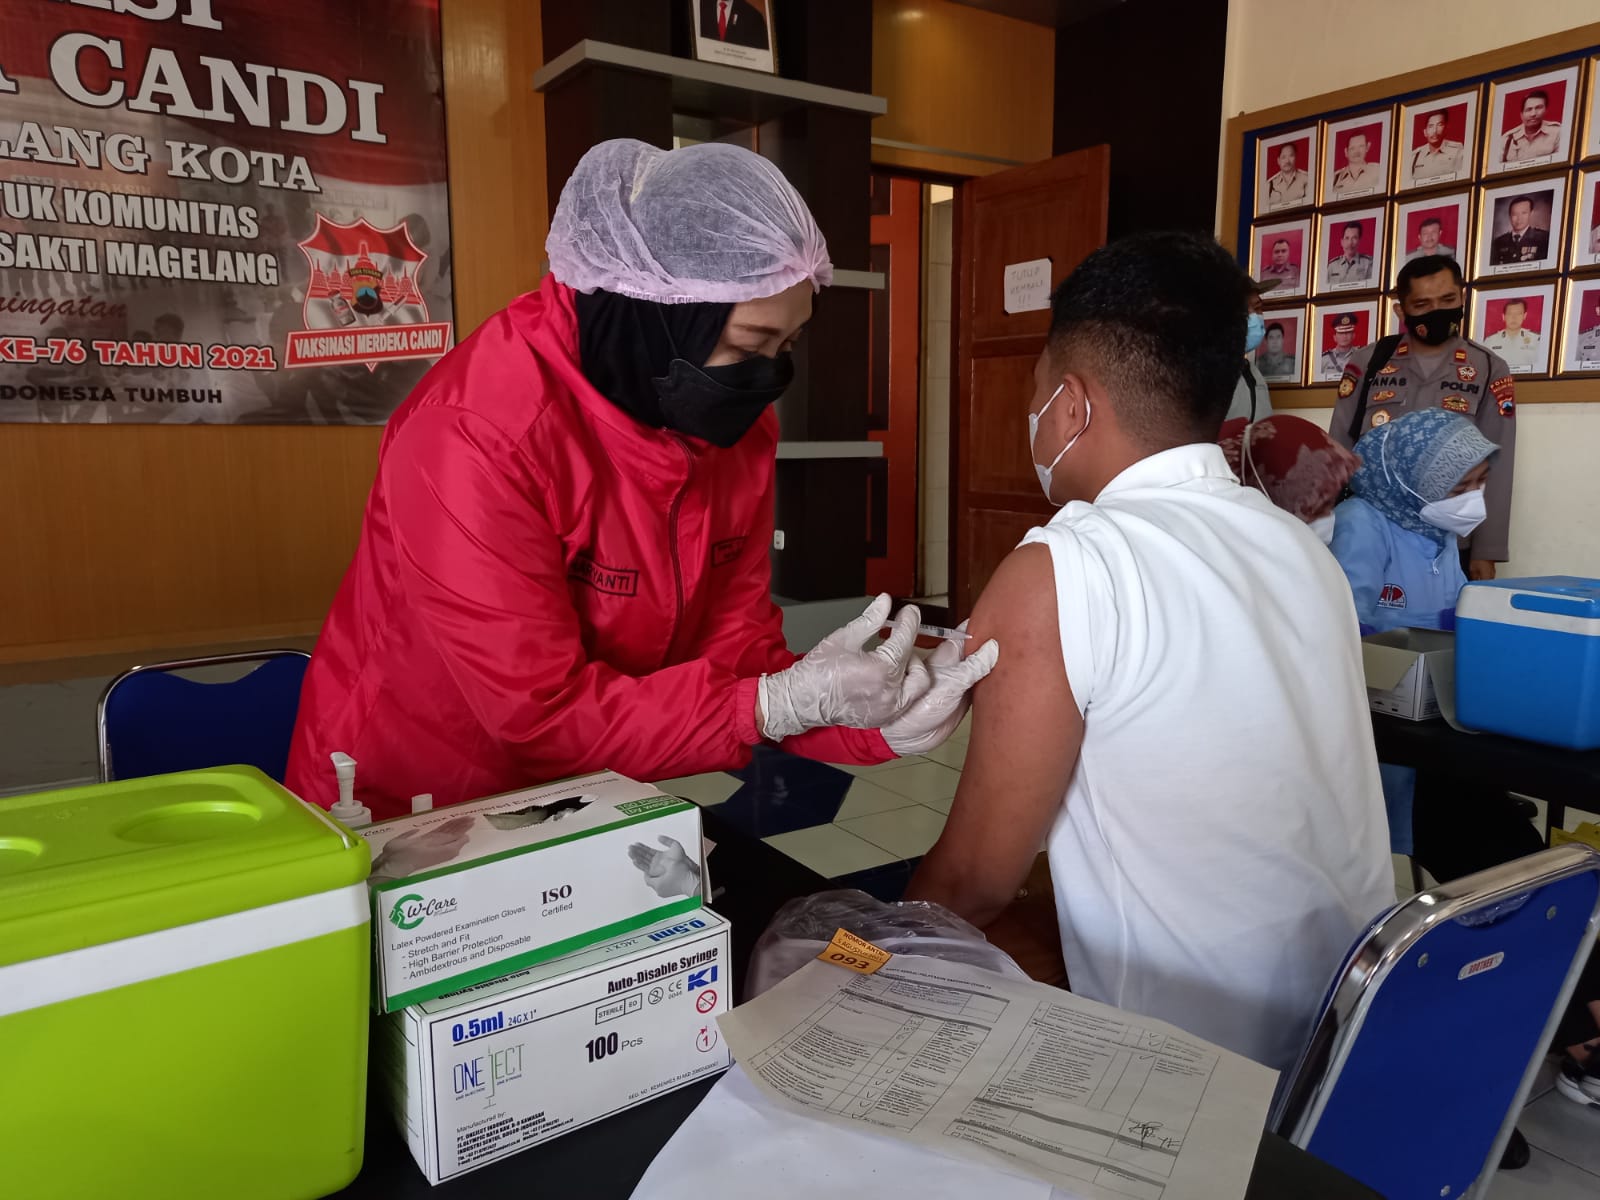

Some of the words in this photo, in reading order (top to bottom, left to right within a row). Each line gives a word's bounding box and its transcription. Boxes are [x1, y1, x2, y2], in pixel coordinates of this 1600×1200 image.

[50, 32, 387, 144] CANDI
[165, 140, 320, 192] KOTA
[0, 183, 57, 222] UK
[63, 188, 259, 239] KOMUNITAS
[105, 241, 279, 286] MAGELANG
[93, 341, 202, 369] TAHUN
[208, 345, 277, 371] 2021
[295, 333, 355, 359] VAKSINASI
[357, 331, 409, 354] MERDEKA
[410, 329, 442, 350] CANDI
[124, 388, 223, 405] TUMBUH
[1440, 381, 1480, 394] POLRI
[541, 884, 573, 905] ISO
[541, 902, 574, 918] Certified
[391, 938, 413, 951] Latex
[415, 927, 454, 944] Powdered
[455, 914, 500, 932] Examination
[501, 905, 527, 919] Gloves
[843, 932, 867, 949] NOMOR
[408, 944, 439, 959] Stretch
[441, 938, 457, 950] and
[459, 933, 470, 944] Fit
[408, 957, 430, 972] High
[431, 948, 460, 963] Barrier
[462, 934, 504, 953] Protection
[409, 956, 468, 980] Ambidextrous
[469, 948, 485, 960] and
[487, 934, 532, 955] Disposable
[829, 953, 870, 970] 093
[607, 958, 678, 994] Auto-Disable
[679, 947, 718, 972] Syringe
[598, 1004, 624, 1018] STERILE
[628, 1000, 638, 1008] EO
[452, 1011, 504, 1043] 0.5ml
[508, 1014, 522, 1027] 24G
[523, 1012, 529, 1021] X
[585, 1032, 619, 1064] 100
[621, 1037, 644, 1051] Pcs
